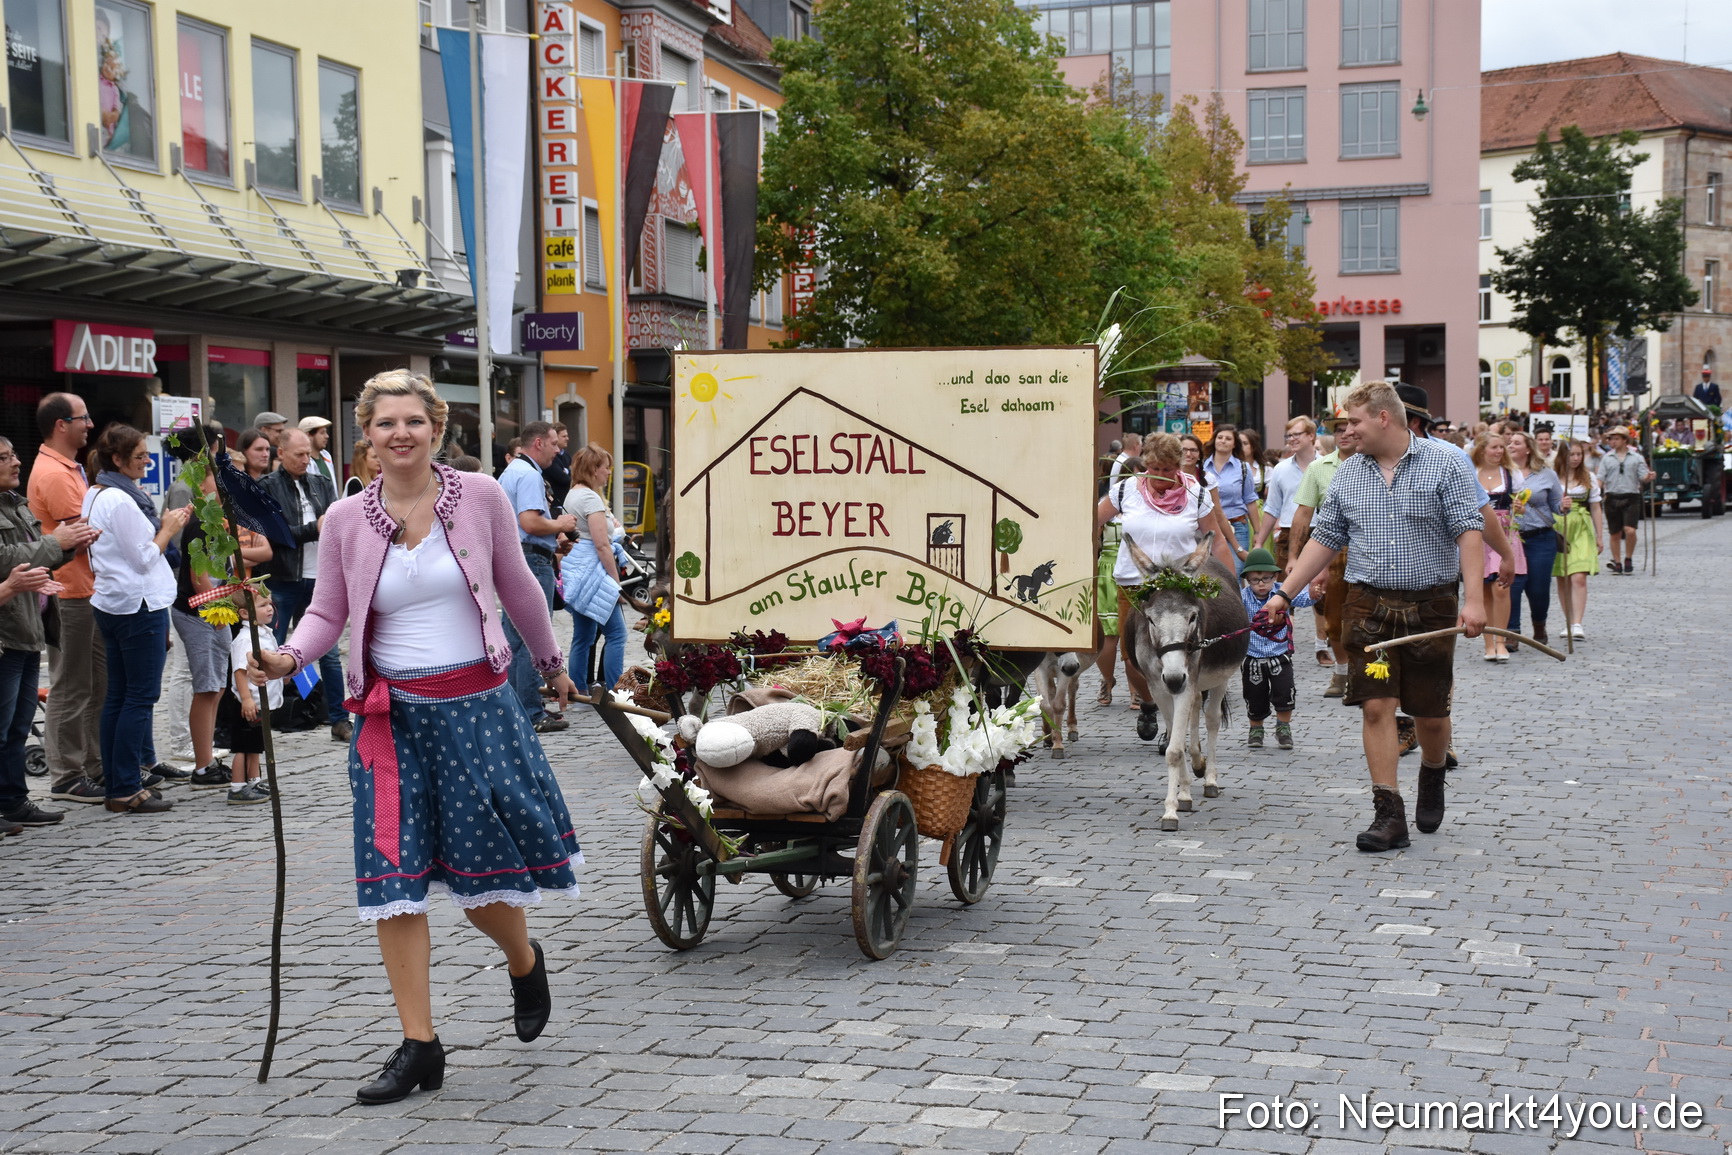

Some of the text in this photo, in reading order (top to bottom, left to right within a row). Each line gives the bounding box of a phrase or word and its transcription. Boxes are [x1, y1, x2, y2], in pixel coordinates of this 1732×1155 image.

[11, 41, 38, 63] SEITE
[180, 71, 203, 102] LE
[546, 239, 575, 258] café
[547, 273, 576, 291] plank
[1294, 295, 1403, 320] arkasse
[527, 321, 576, 343] liberty
[69, 323, 158, 375] ADLER
[984, 368, 1011, 385] dao
[1018, 374, 1042, 385] san
[1048, 368, 1069, 384] die
[960, 397, 1055, 414] Esel dahoam
[749, 432, 927, 475] ESELSTALL
[771, 500, 891, 538] BEYER
[749, 557, 966, 630] am Staufer Berg
